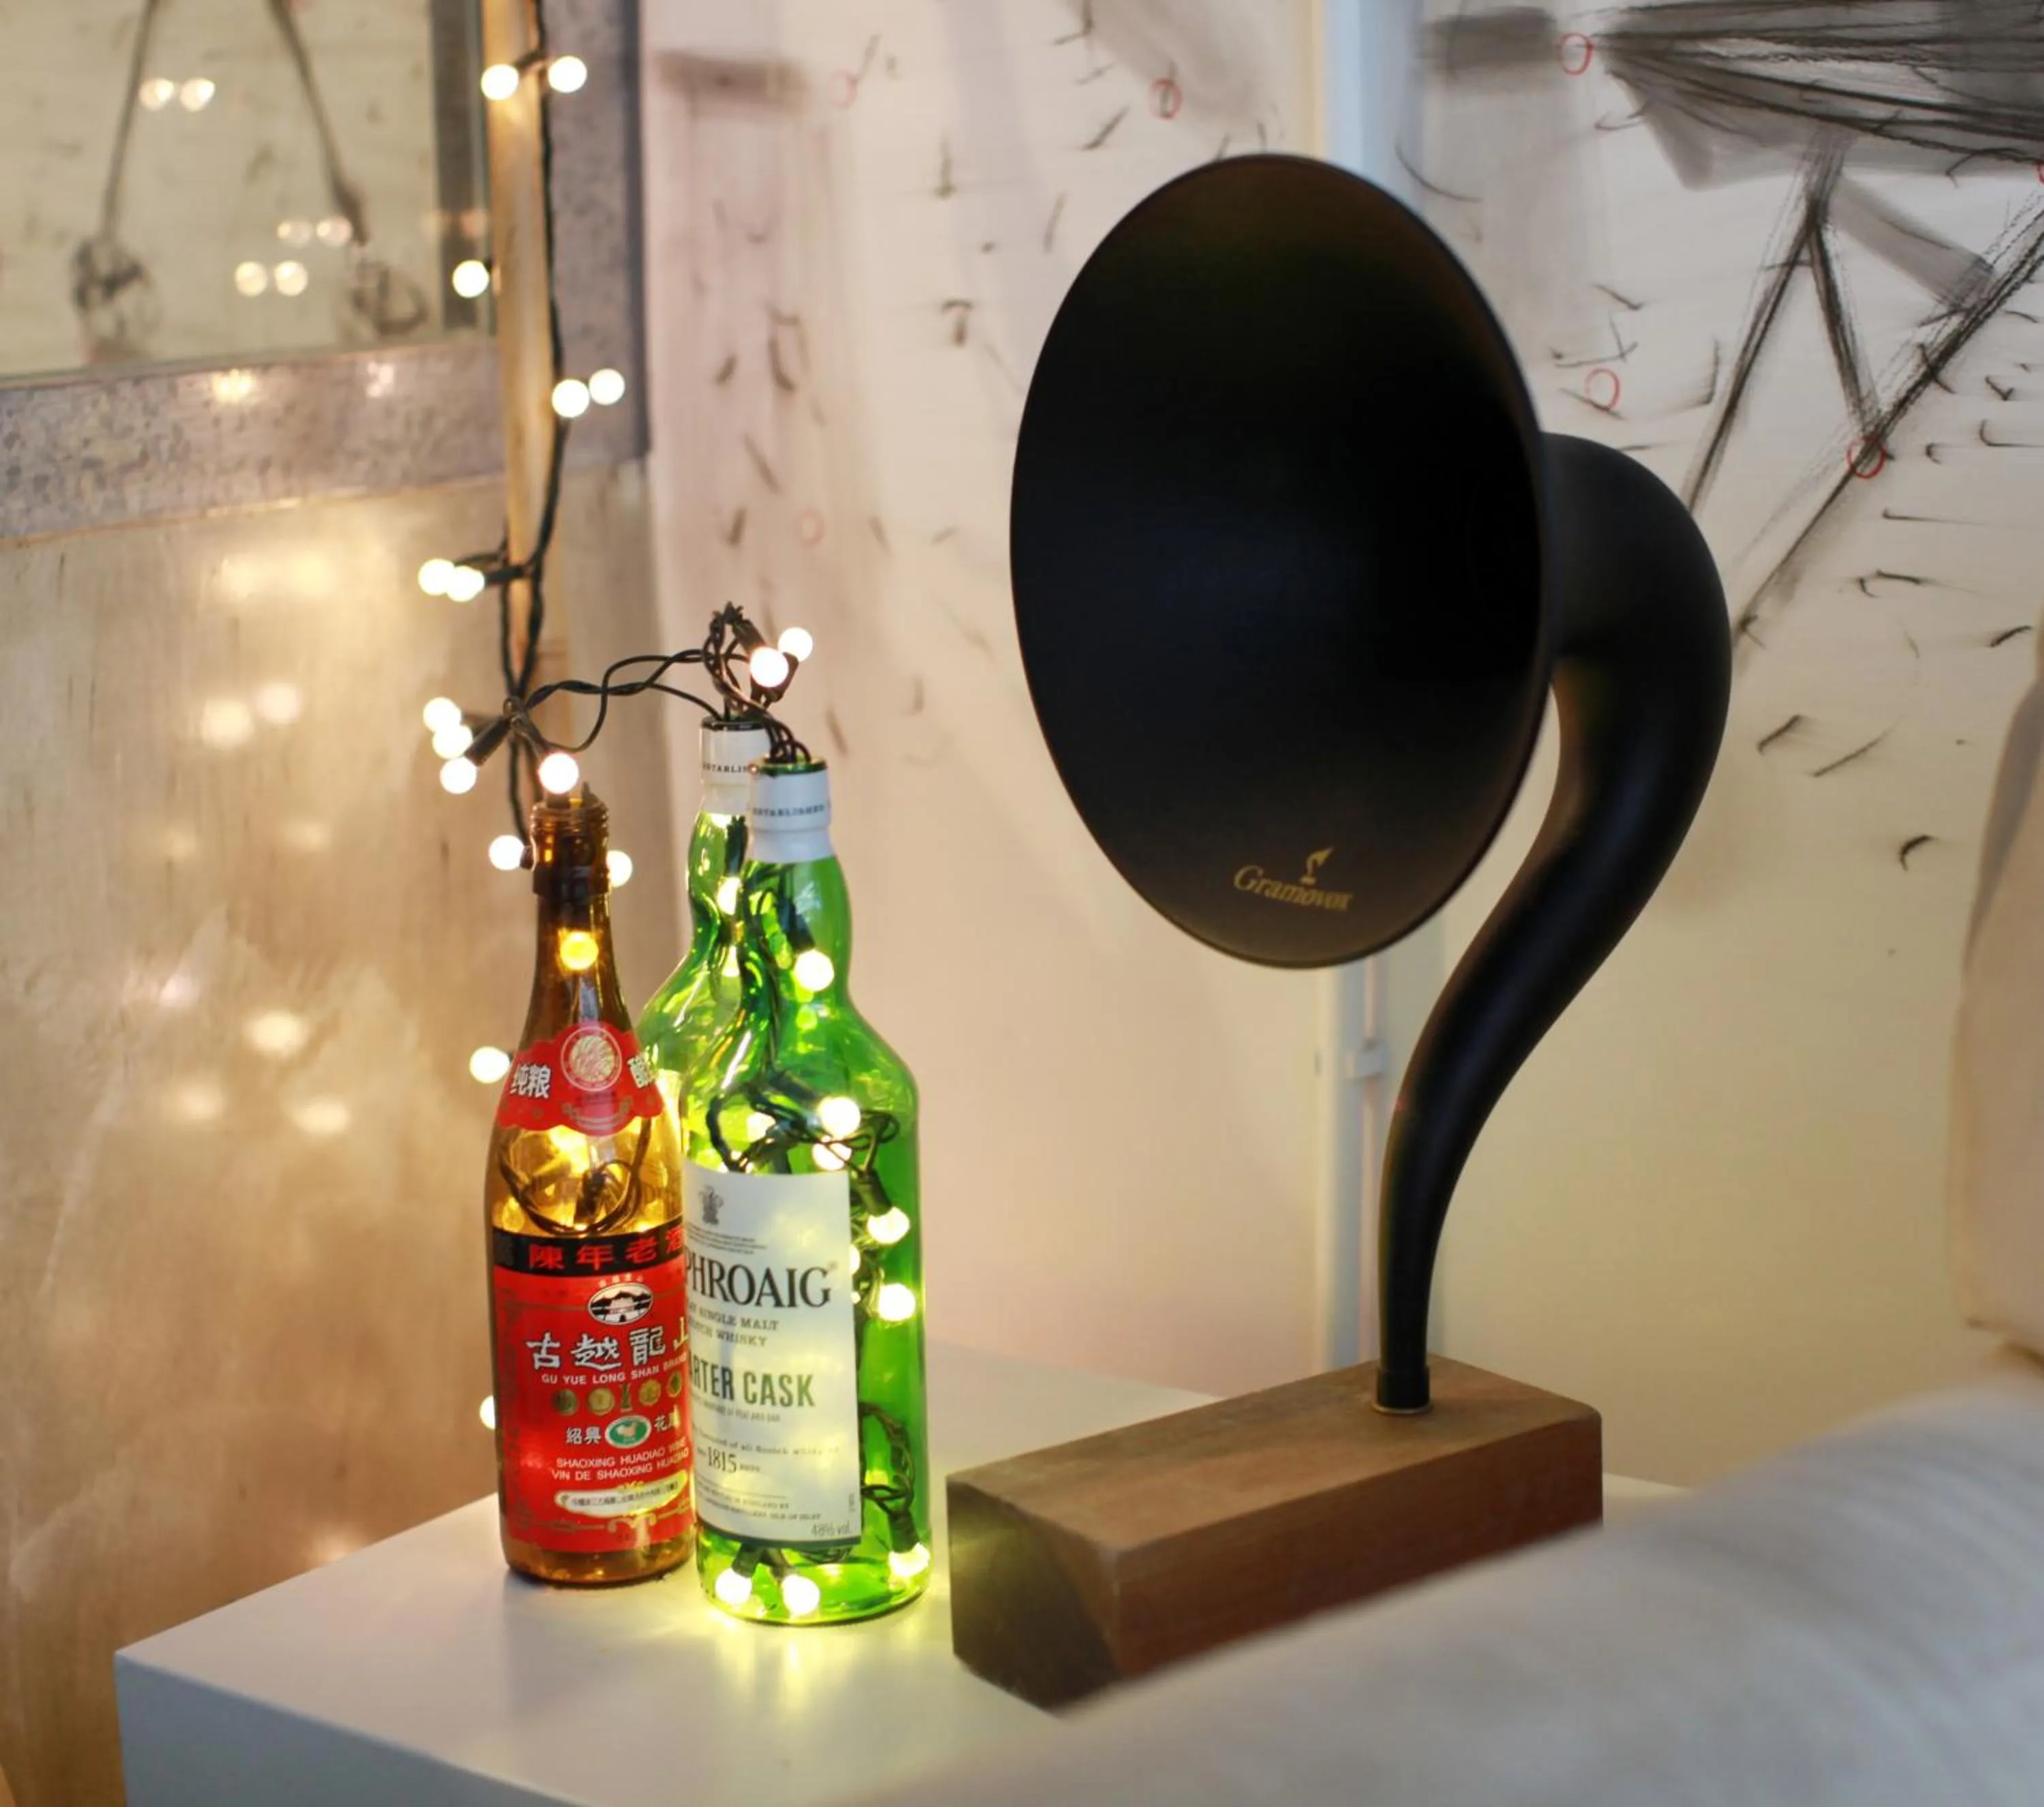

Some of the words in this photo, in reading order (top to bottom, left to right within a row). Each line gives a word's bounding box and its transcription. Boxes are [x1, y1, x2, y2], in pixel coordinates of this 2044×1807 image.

[683, 1246, 831, 1308] PHROAIG
[741, 1317, 779, 1331] MALT
[542, 1373, 557, 1384] GU
[563, 1375, 586, 1385] YUE
[592, 1373, 625, 1385] LONG
[631, 1364, 660, 1380] SHAN
[689, 1351, 734, 1401] RTER
[743, 1372, 815, 1407] CASK
[556, 1457, 615, 1468] SHAOXING
[621, 1447, 666, 1464] HUADIAO
[708, 1446, 738, 1473] 1815
[551, 1469, 570, 1481] VIN
[575, 1470, 591, 1481] DE
[597, 1464, 653, 1481] SHAOXING
